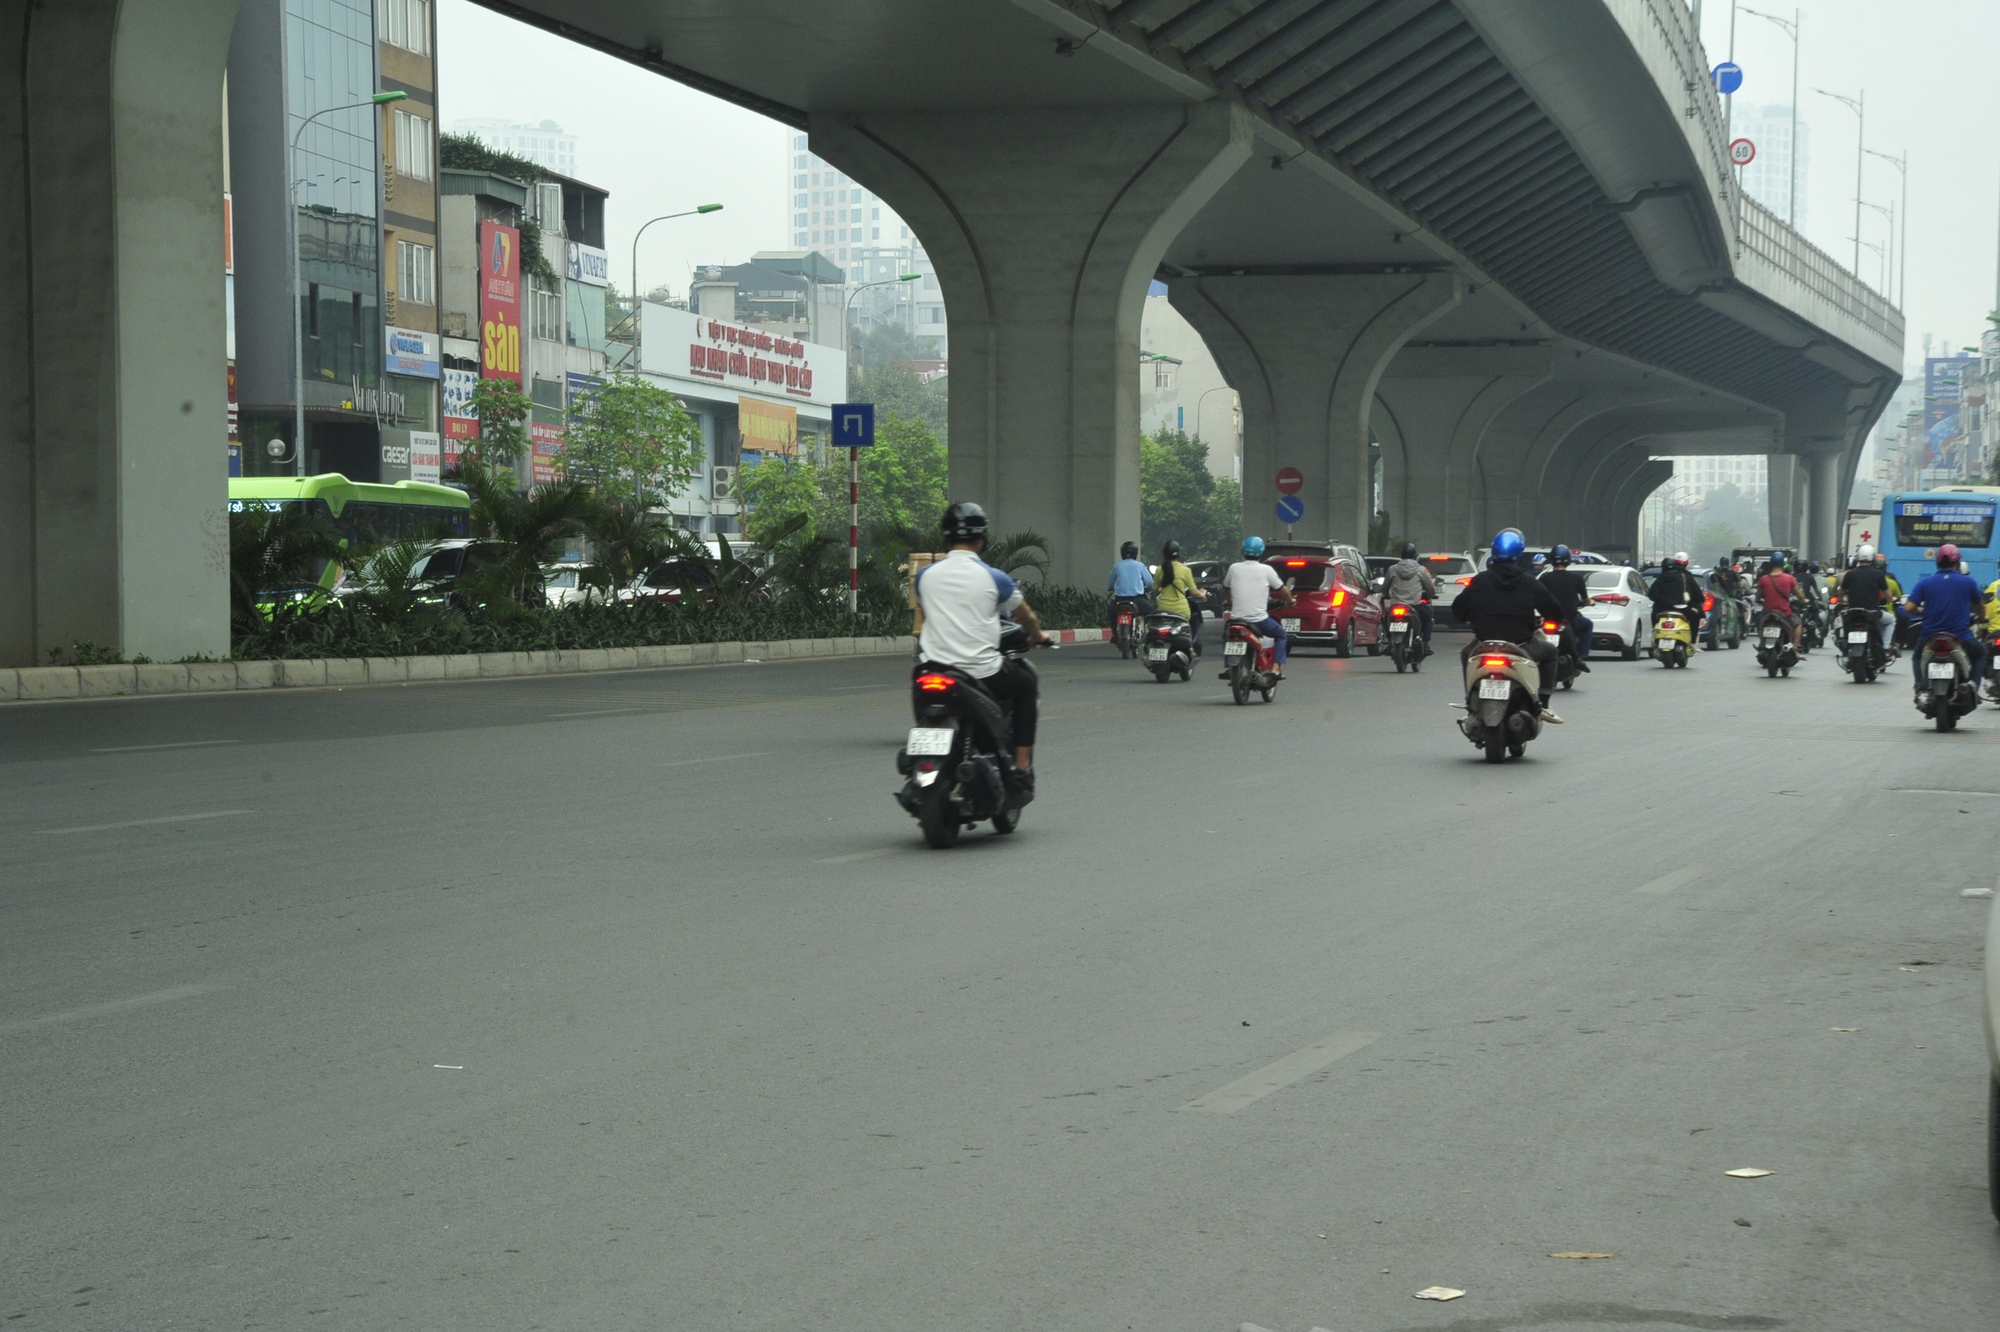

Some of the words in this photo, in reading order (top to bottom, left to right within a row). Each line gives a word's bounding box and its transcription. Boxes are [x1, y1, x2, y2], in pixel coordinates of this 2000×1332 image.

[1735, 146, 1748, 158] 60
[484, 312, 520, 375] sàn
[690, 343, 706, 369] KHU
[707, 343, 728, 373] KHÁM
[729, 347, 748, 377] CHỮA
[749, 351, 767, 386] BỆNH
[768, 360, 784, 385] THEO
[785, 359, 798, 387] YÊU
[799, 360, 812, 390] CẦU
[382, 446, 410, 464] caesar
[1904, 505, 1920, 515] 19
[1913, 523, 1930, 531] BUS
